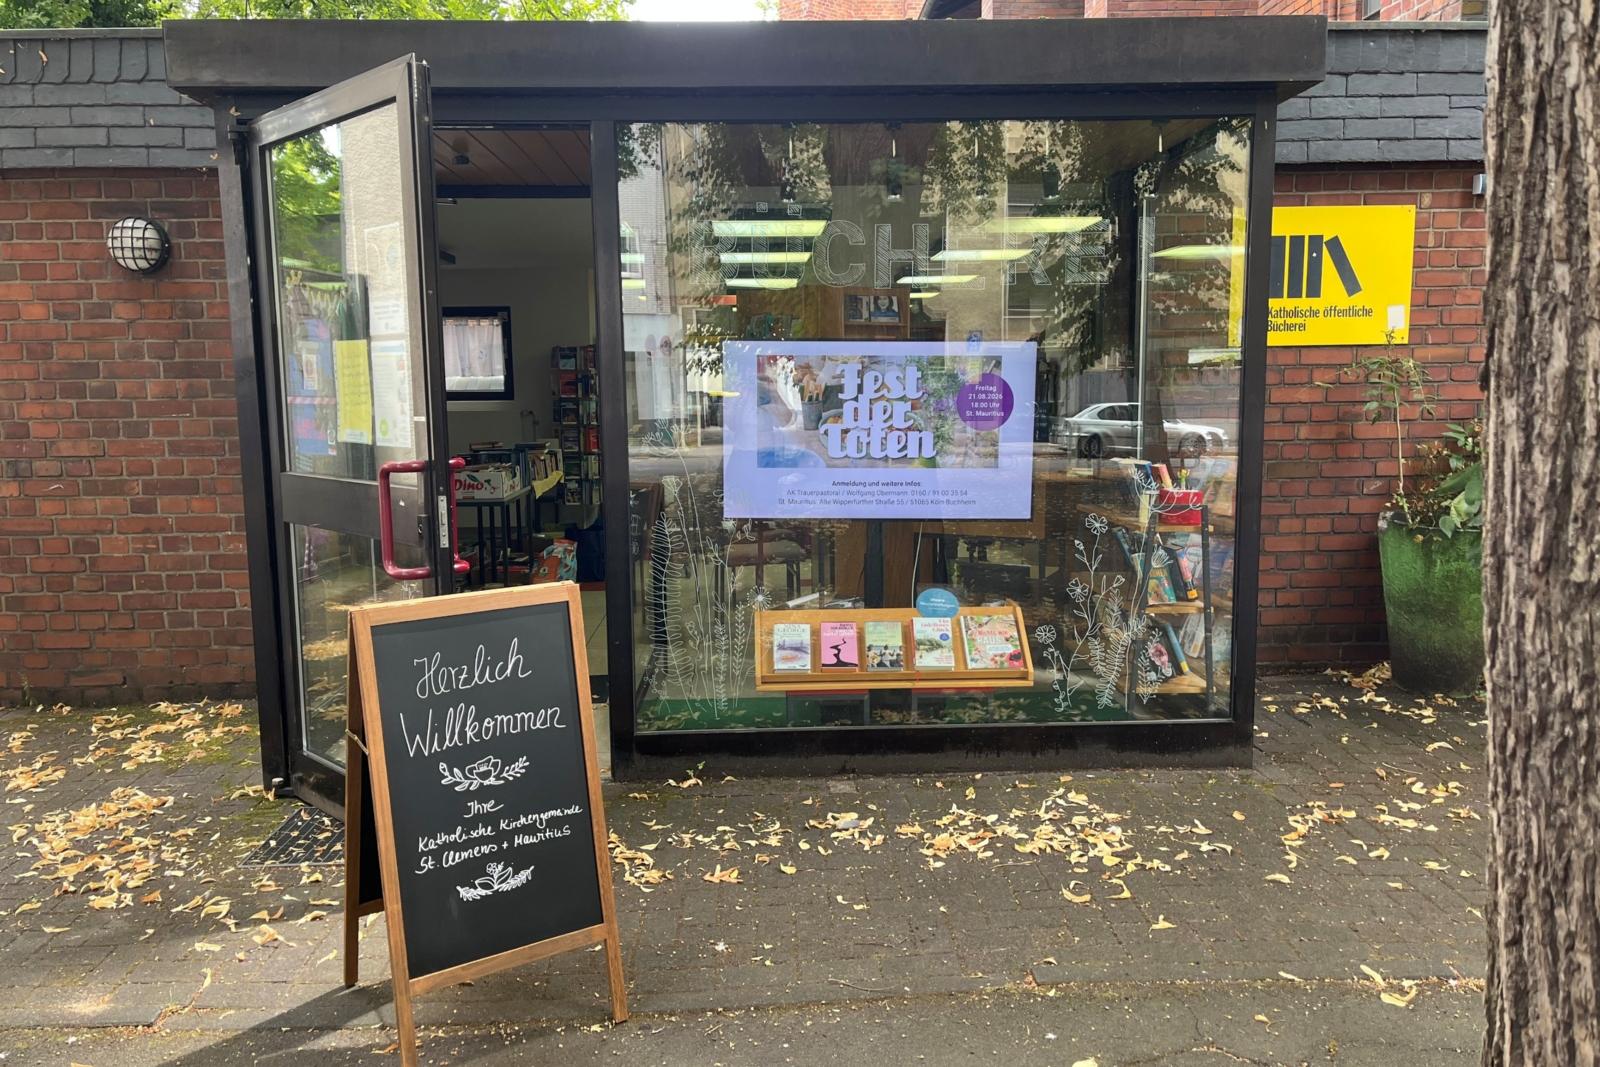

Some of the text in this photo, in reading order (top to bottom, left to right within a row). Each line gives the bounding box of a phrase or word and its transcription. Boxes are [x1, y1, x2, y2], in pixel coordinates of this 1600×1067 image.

[1267, 319, 1306, 332] Bücherei
[1323, 305, 1373, 318] öffentliche
[835, 363, 924, 400] Fest
[975, 385, 997, 393] Freitag
[842, 394, 914, 430] der
[819, 423, 937, 460] Toten
[832, 480, 867, 488] Anmeldung
[846, 489, 876, 498] Wolfgang
[413, 637, 532, 699] Herzlich
[399, 703, 567, 758] Willkommen
[463, 799, 504, 818] Ihre
[418, 804, 583, 852] Katholische Kirchengemeinde
[414, 855, 440, 874] St.
[442, 843, 498, 867] Clemens
[514, 824, 571, 848] Mauritius
